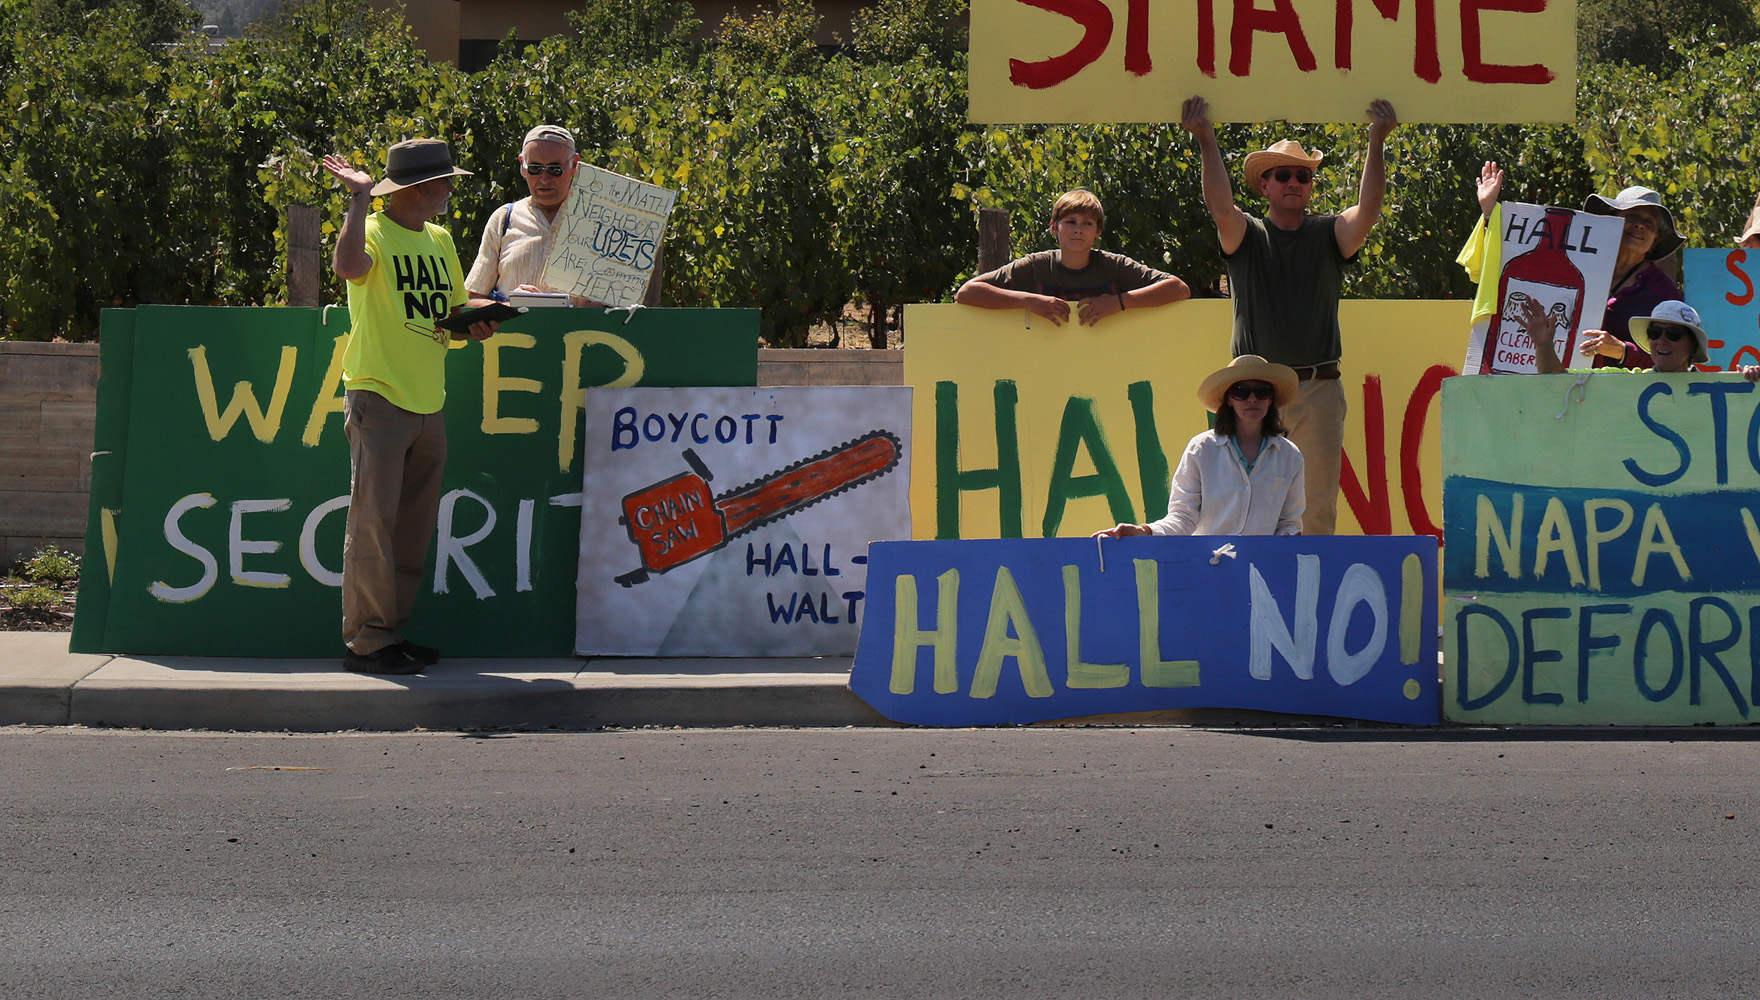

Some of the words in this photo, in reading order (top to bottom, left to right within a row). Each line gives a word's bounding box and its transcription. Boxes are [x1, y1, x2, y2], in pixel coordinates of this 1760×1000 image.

[1503, 213, 1598, 255] HALL
[611, 406, 784, 451] BOYCOTT
[634, 489, 704, 531] CHAIN
[652, 519, 699, 555] SAW
[1474, 493, 1692, 592] NAPA
[766, 591, 865, 625] WALT
[889, 558, 1201, 699] HALL
[1248, 552, 1423, 700] NO!
